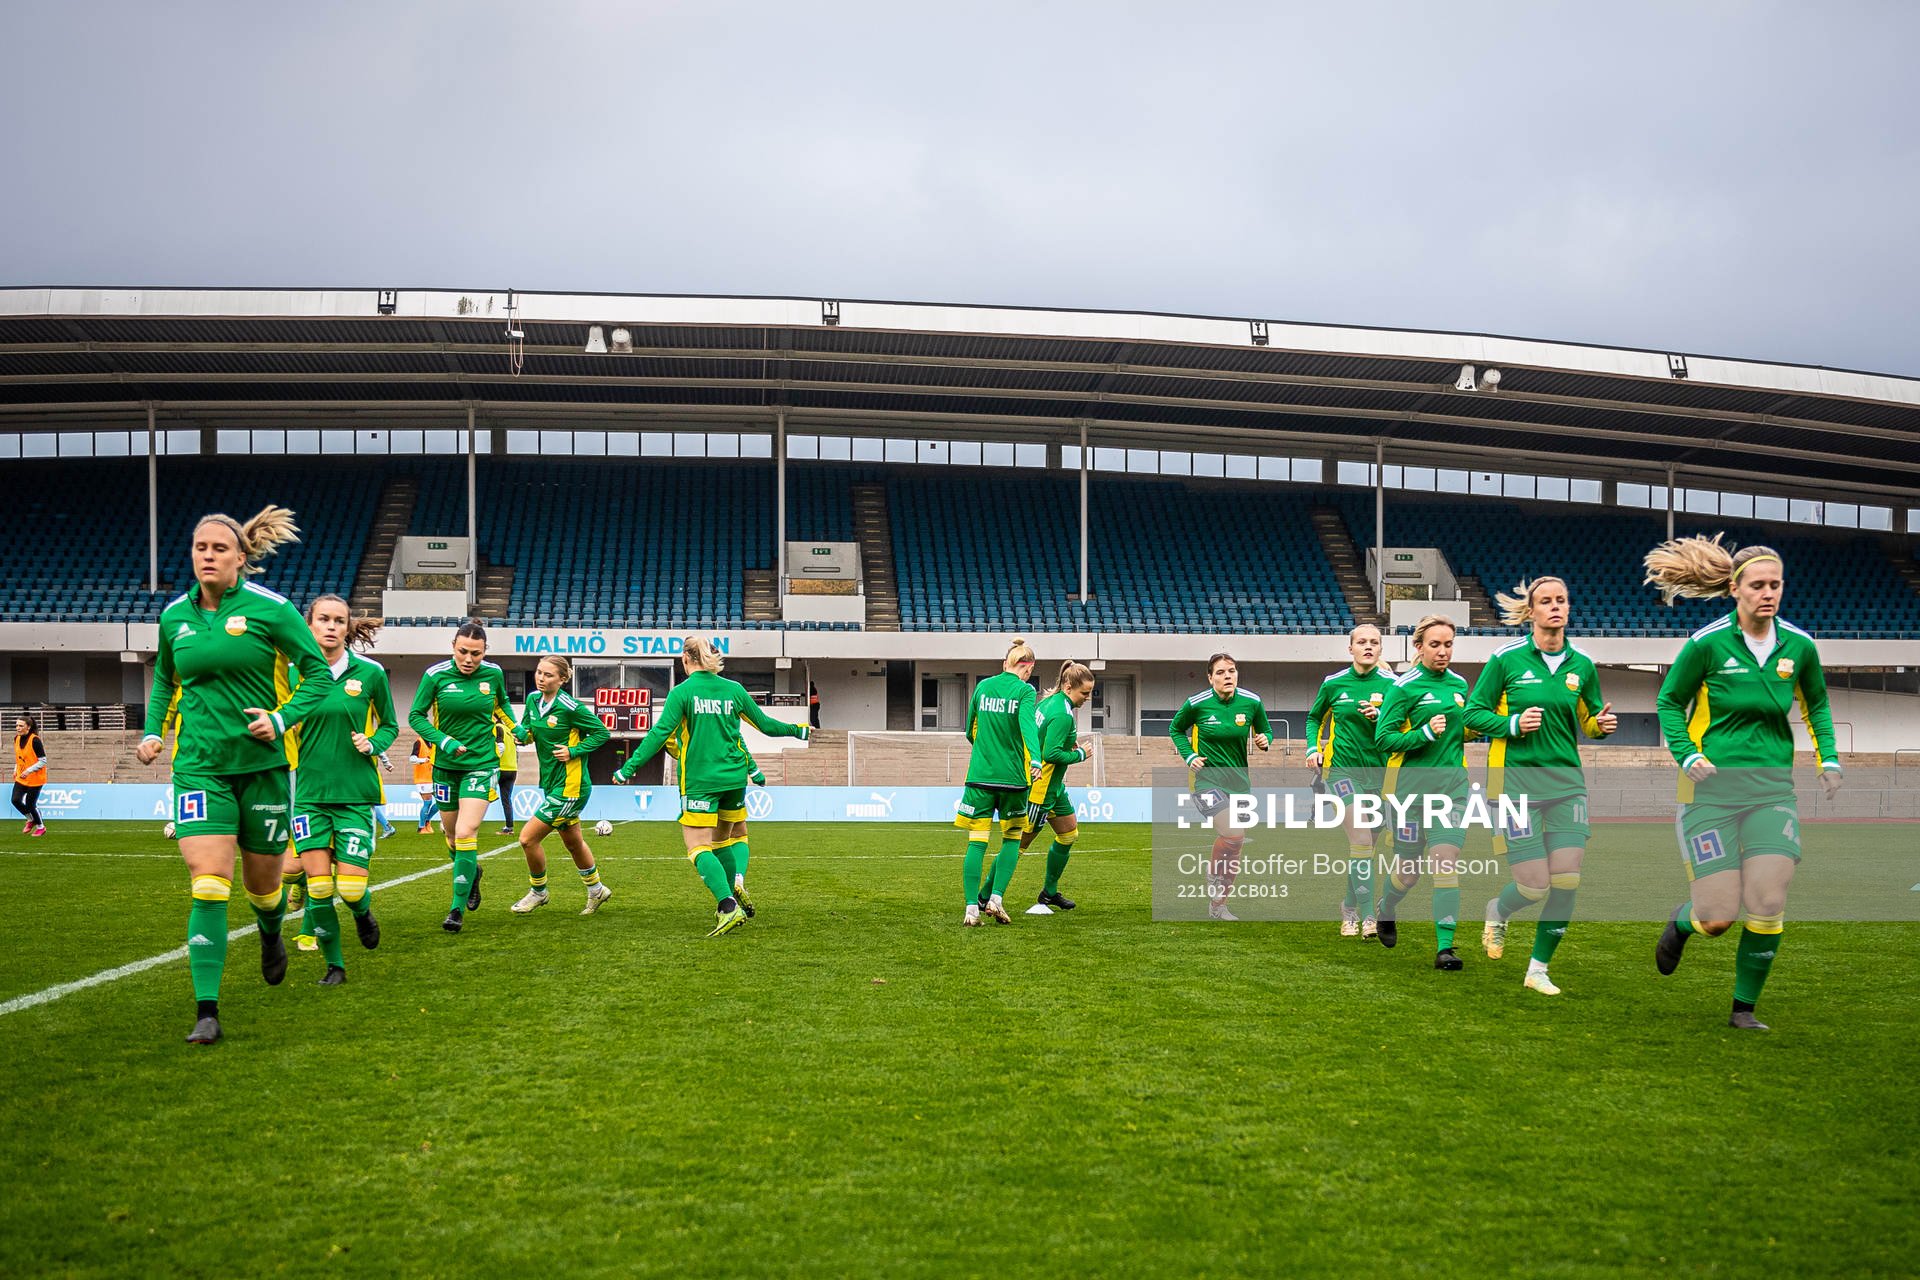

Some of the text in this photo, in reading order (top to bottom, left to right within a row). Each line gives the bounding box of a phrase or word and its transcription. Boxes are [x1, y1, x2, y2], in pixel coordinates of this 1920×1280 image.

[515, 631, 729, 654] MALMÖ STADN
[598, 689, 649, 705] 00:00
[693, 695, 734, 715] ÅHUS IF
[979, 694, 1019, 714] ÅHUS IF
[605, 713, 648, 730] 0 0
[467, 777, 478, 792] 3
[540, 801, 551, 814] 2
[846, 803, 886, 817] PUMA
[1077, 802, 1114, 820] ApQ
[264, 819, 278, 842] 7
[1782, 819, 1794, 841] 4
[346, 836, 361, 856] 6
